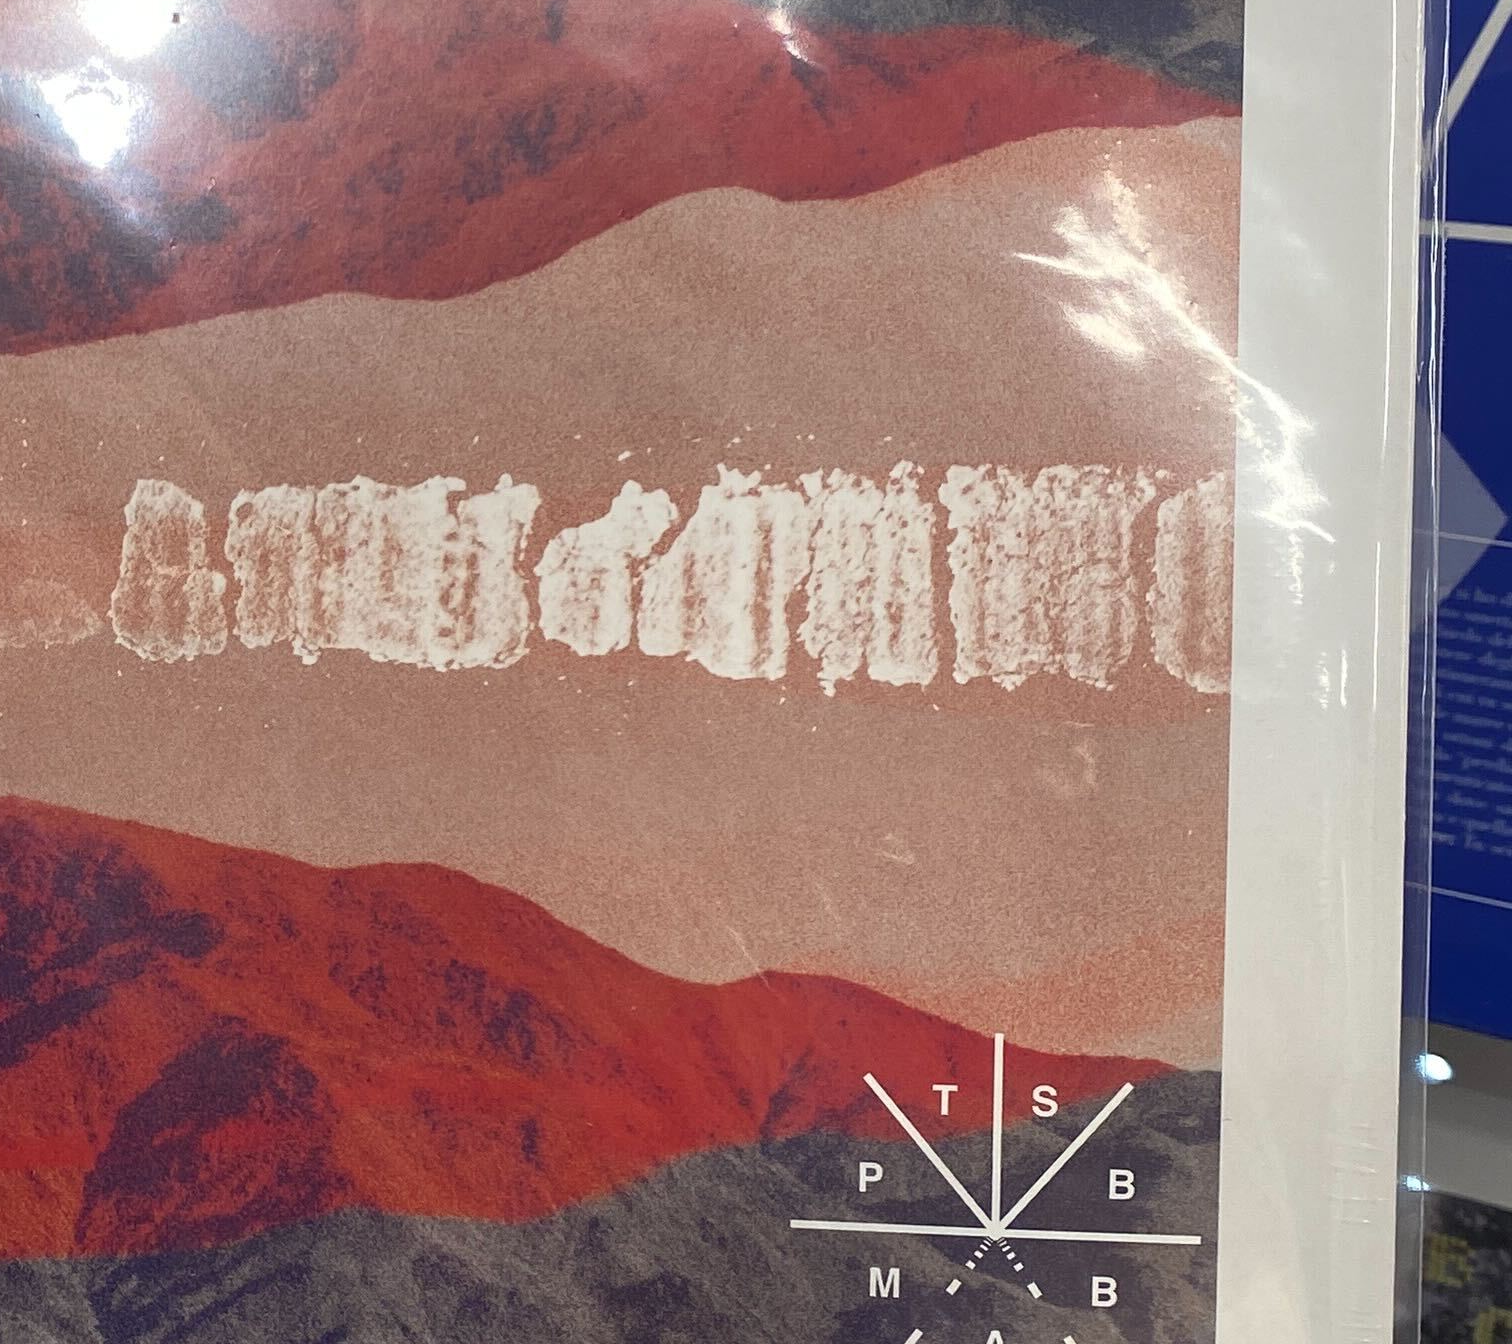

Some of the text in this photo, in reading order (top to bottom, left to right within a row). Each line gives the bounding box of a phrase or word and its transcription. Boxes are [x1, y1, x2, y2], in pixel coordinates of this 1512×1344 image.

[933, 1084, 958, 1116] T
[1032, 1085, 1058, 1117] S
[859, 1162, 883, 1192] P
[1108, 1169, 1136, 1200] B
[869, 1267, 900, 1299] M
[1091, 1276, 1118, 1307] B
